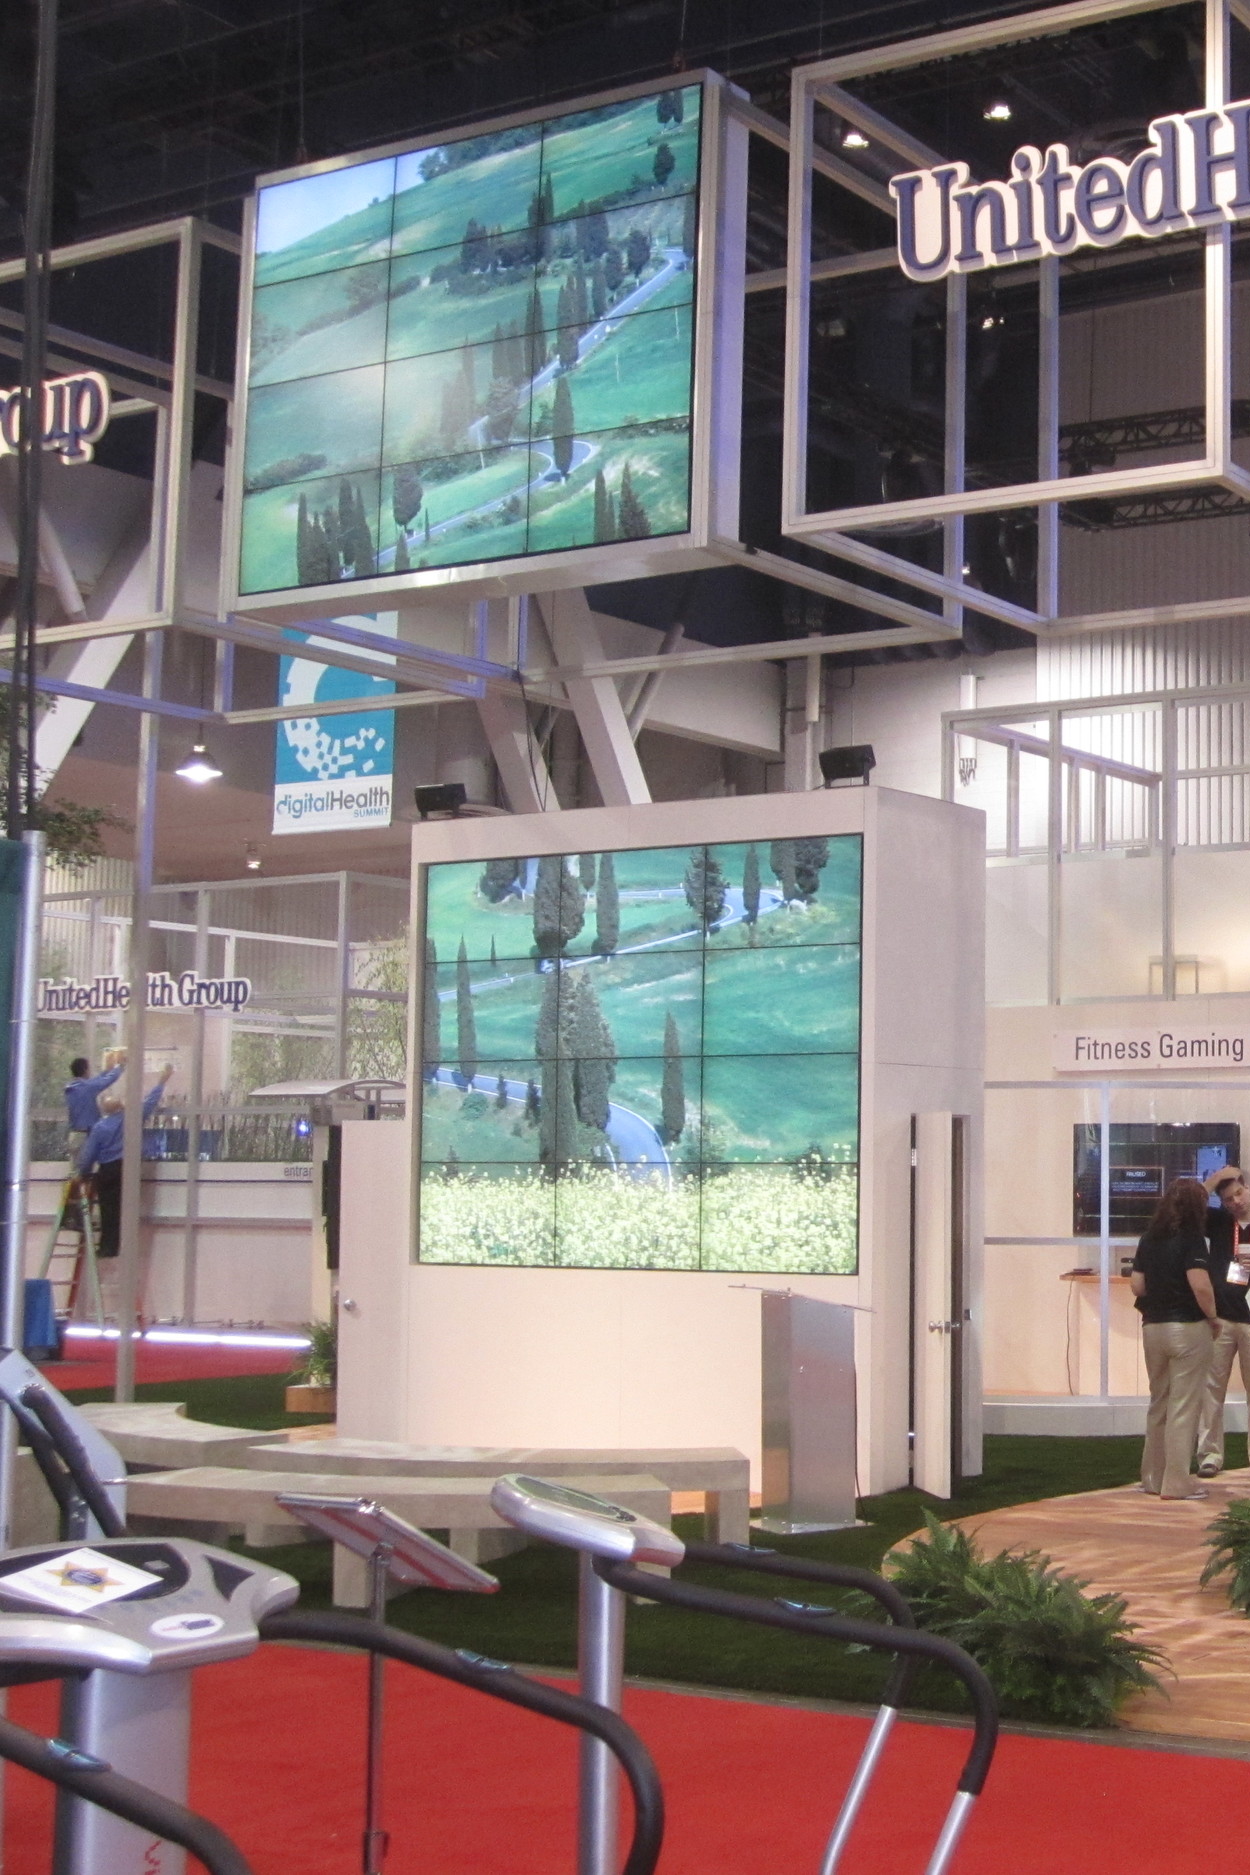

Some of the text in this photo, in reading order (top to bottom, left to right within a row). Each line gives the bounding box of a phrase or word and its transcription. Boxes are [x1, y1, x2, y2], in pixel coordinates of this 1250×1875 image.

[276, 786, 390, 819] digitalHealth
[353, 806, 390, 818] SUMMIT
[178, 972, 249, 1012] Group
[1074, 1032, 1245, 1062] Fitness Gaming
